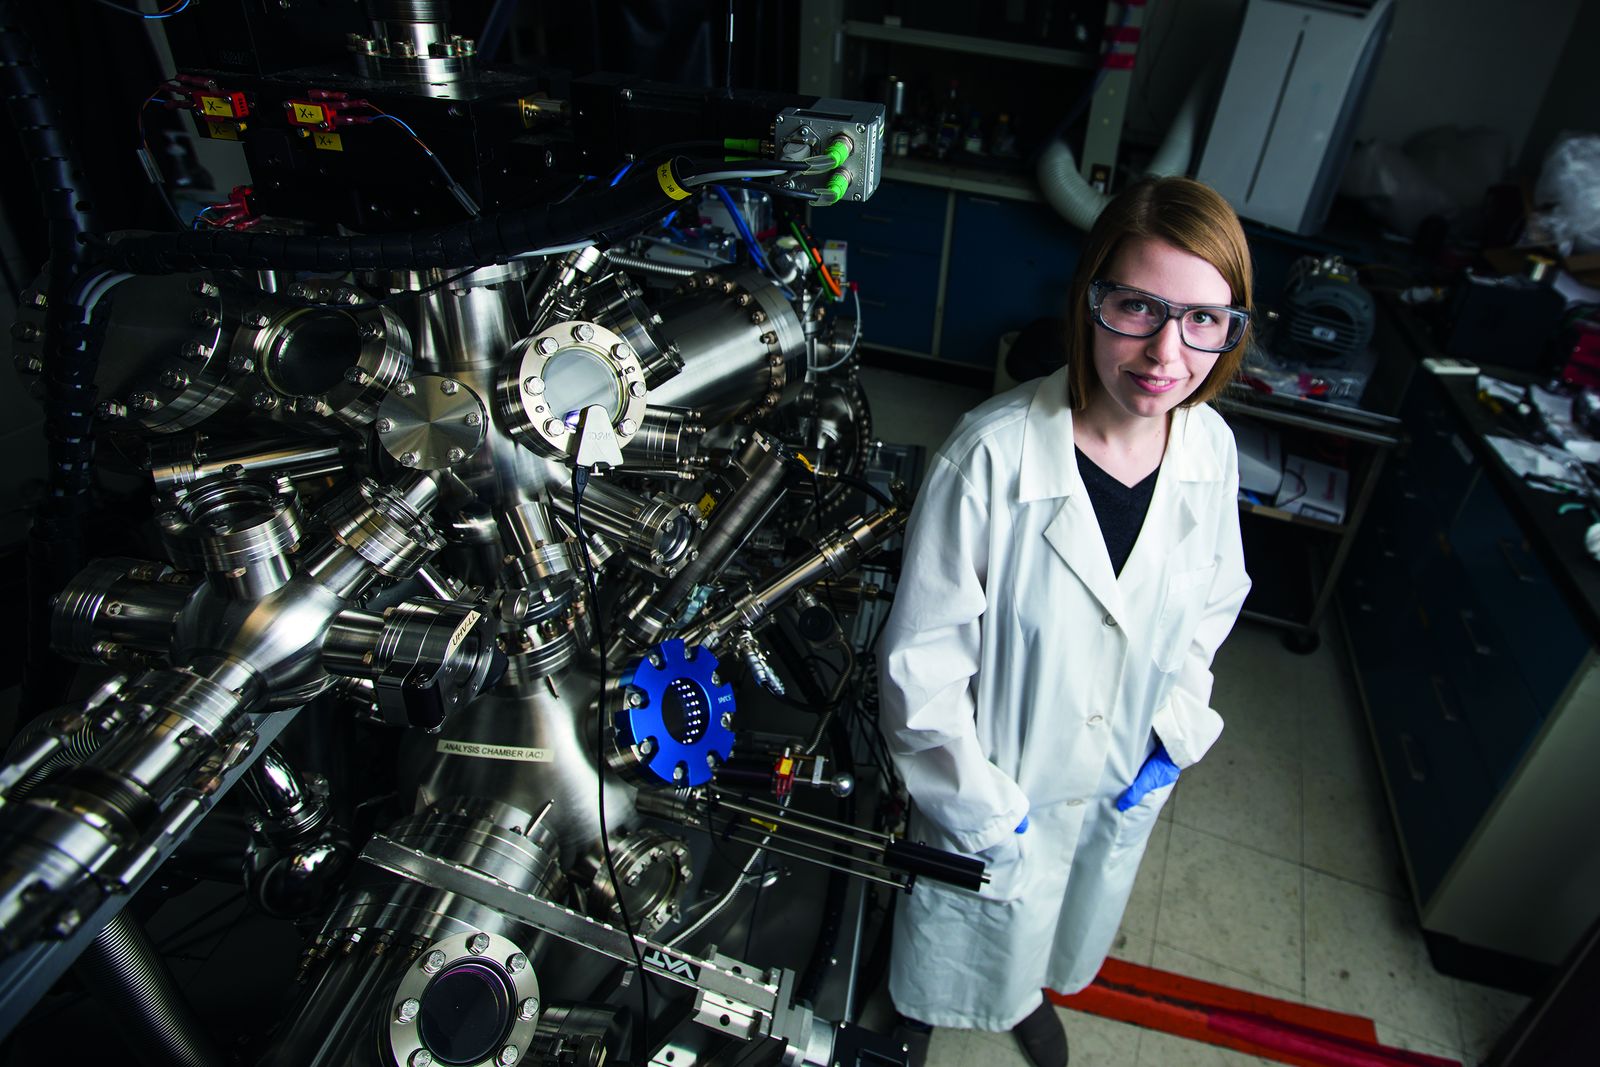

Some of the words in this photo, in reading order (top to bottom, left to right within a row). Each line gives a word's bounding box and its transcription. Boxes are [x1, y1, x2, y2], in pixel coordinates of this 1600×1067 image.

[300, 108, 314, 118] X+
[319, 135, 333, 145] X+
[452, 612, 477, 646] UHV-LL
[444, 743, 480, 753] ANALYSIS
[481, 747, 523, 758] CHAMBER
[525, 750, 544, 759] (AC)
[643, 950, 695, 980] VAT
